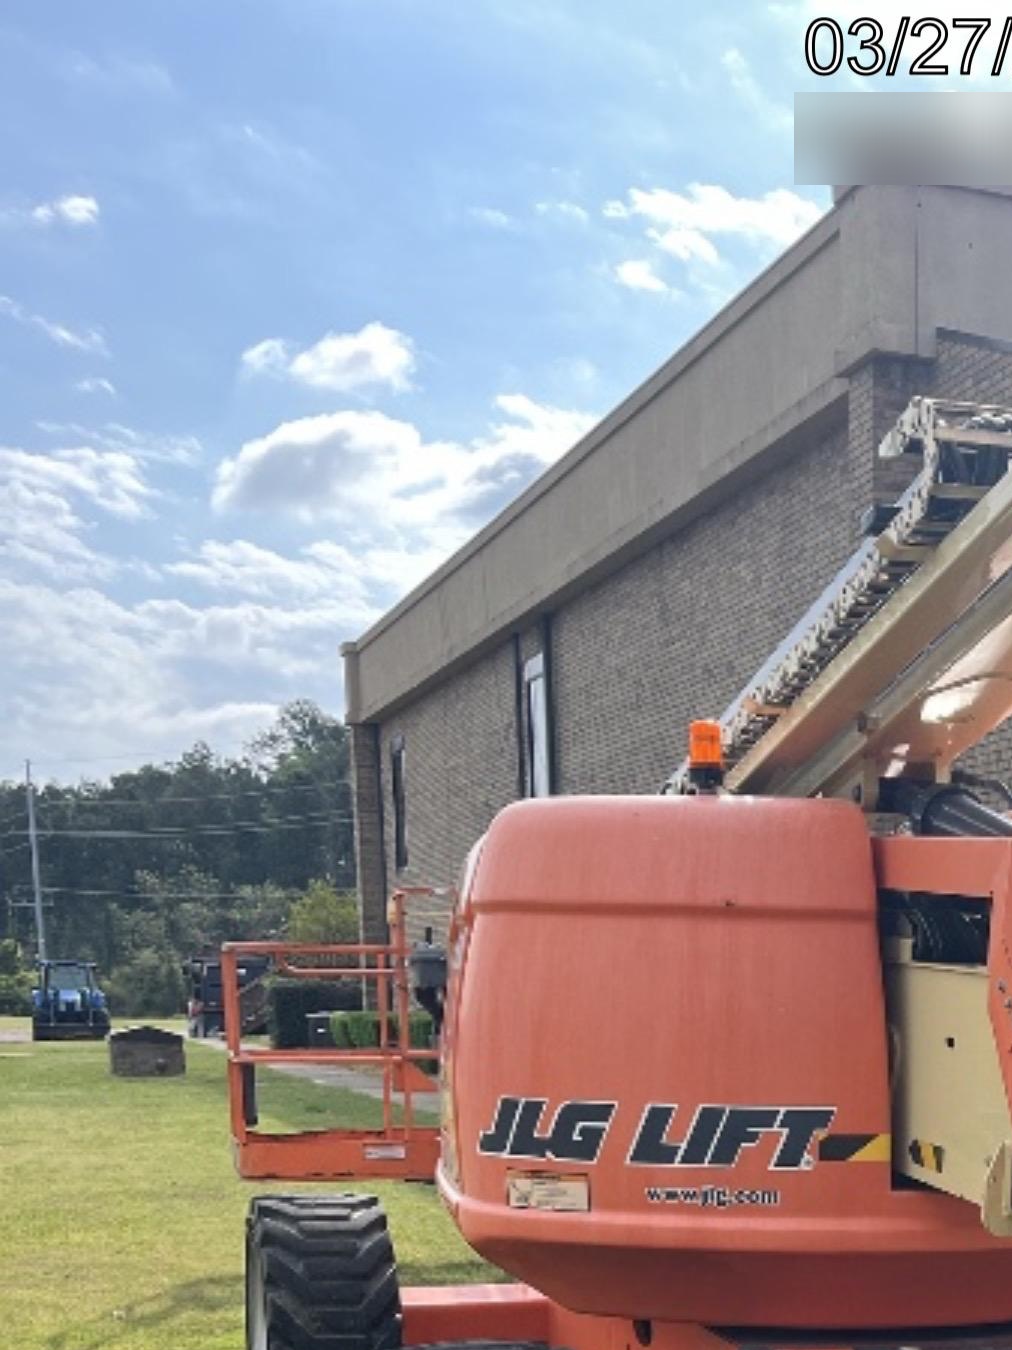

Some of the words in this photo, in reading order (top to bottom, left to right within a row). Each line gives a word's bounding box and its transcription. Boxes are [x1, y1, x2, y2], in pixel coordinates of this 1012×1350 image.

[477, 1096, 618, 1164] JLG
[625, 1103, 837, 1170] LIFT
[645, 1185, 780, 1208] www.jlg.com
